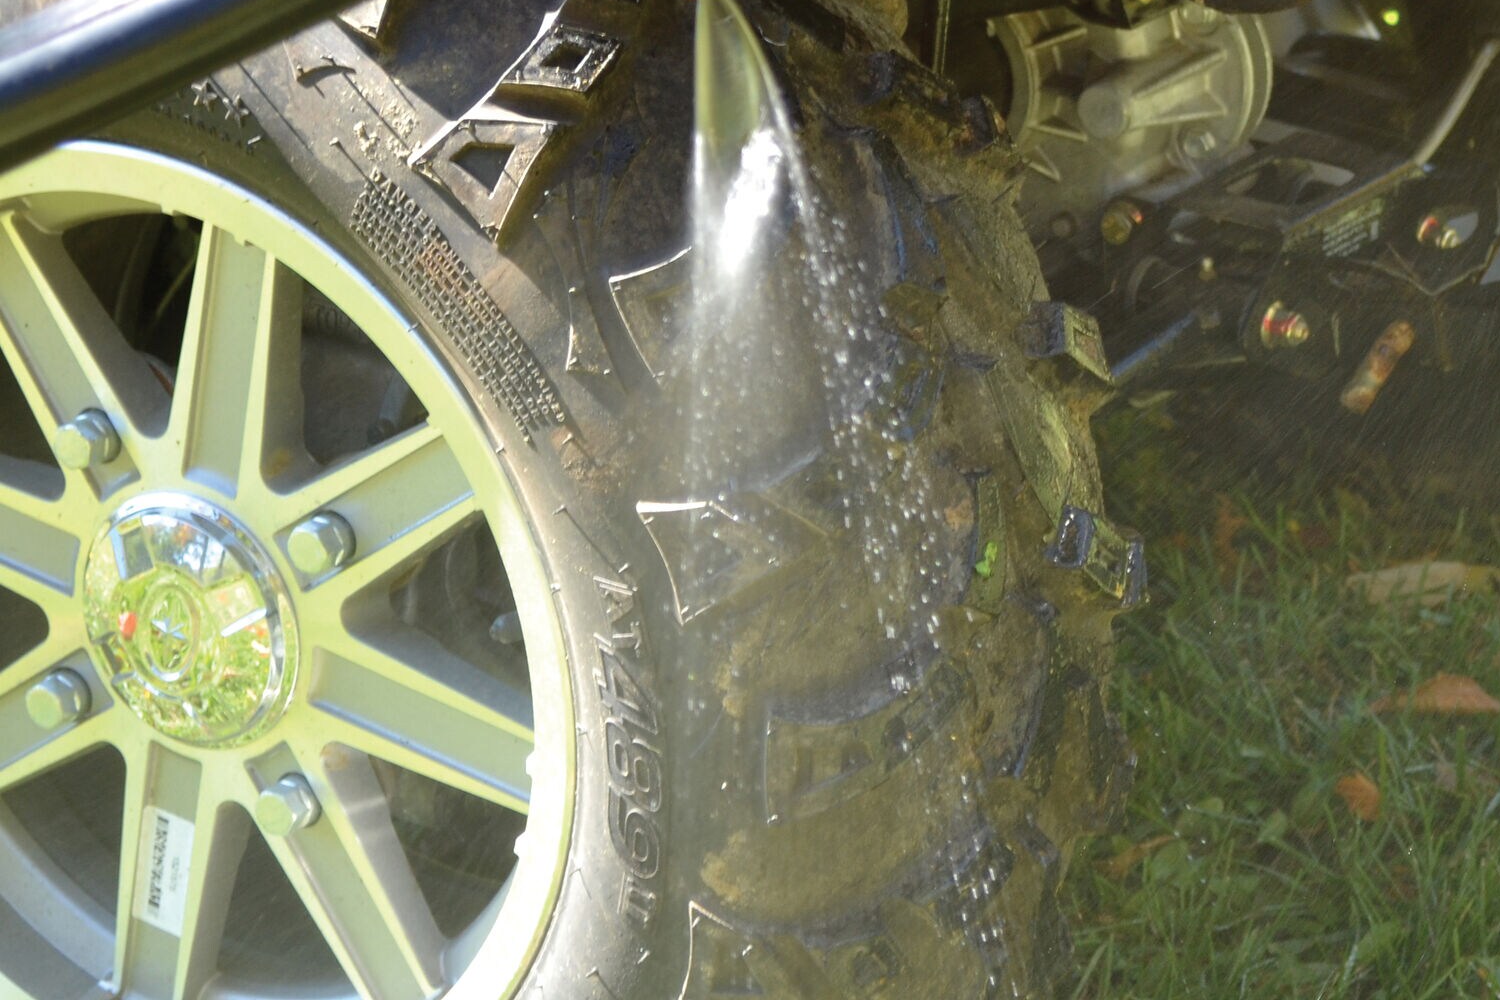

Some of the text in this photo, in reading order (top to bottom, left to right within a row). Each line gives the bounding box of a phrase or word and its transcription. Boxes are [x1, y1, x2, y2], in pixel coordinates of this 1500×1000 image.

[367, 166, 567, 423] DANGER: ONLY SPECIALLY TRAINED
[419, 233, 465, 288] SHOULD
[464, 287, 502, 339] MOUNT
